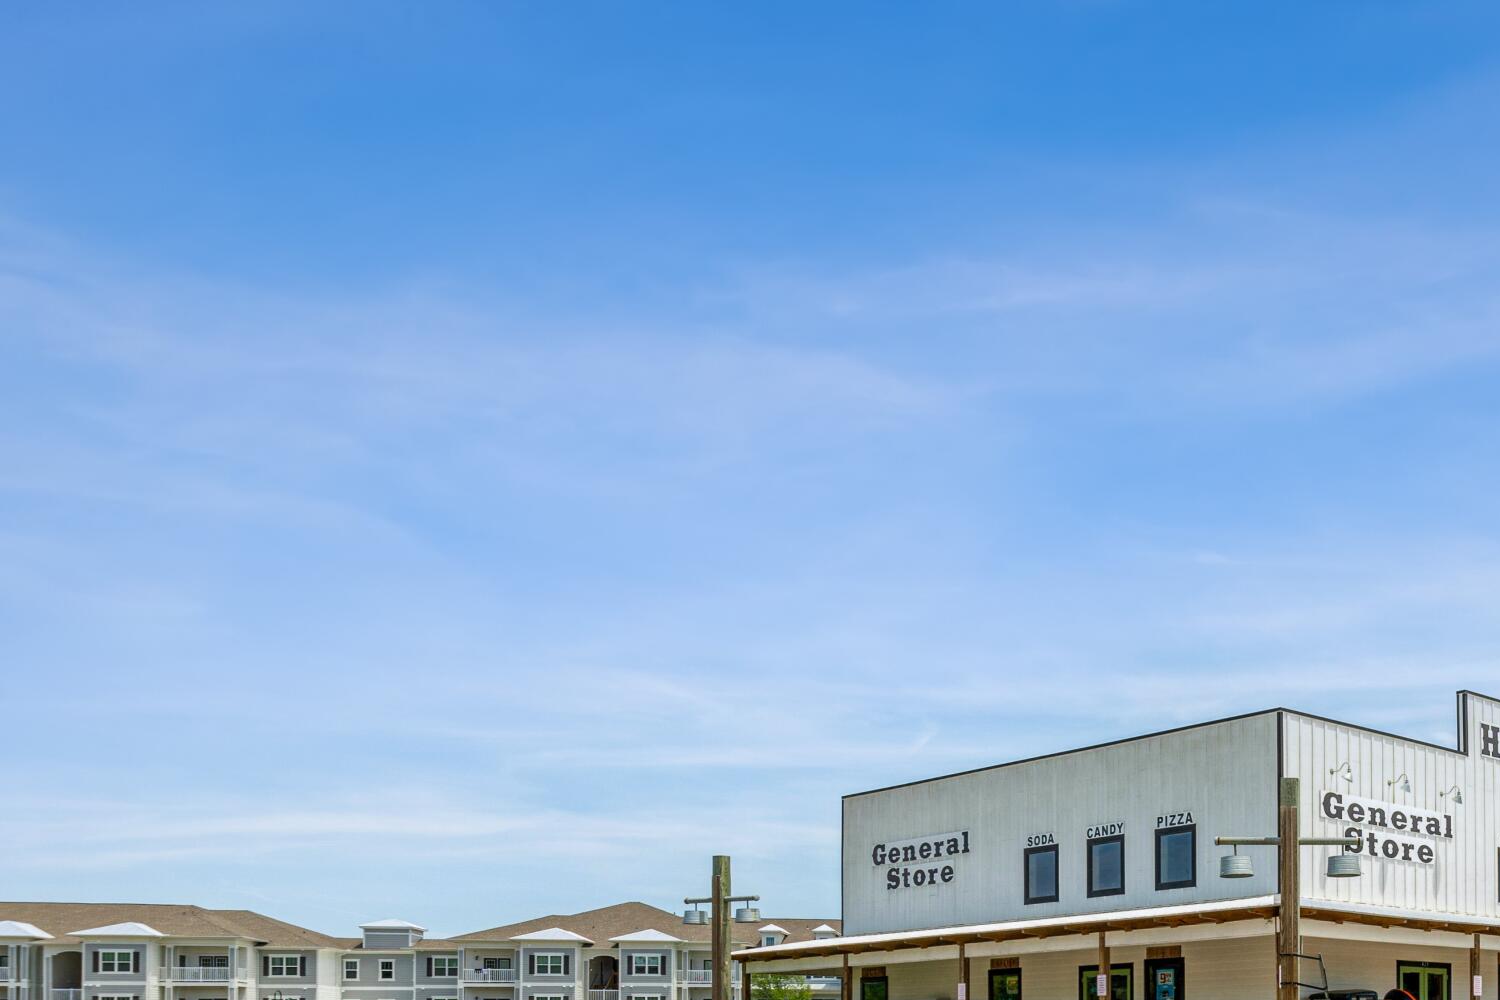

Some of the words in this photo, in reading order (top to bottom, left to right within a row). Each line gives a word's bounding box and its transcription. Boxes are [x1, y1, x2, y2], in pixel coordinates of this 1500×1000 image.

[1156, 811, 1194, 828] PIZZA
[1322, 791, 1453, 839] General
[1027, 833, 1055, 847] SODA
[1086, 822, 1124, 839] CANDY
[872, 831, 970, 866] General
[1344, 826, 1434, 864] Store
[887, 865, 954, 890] Store
